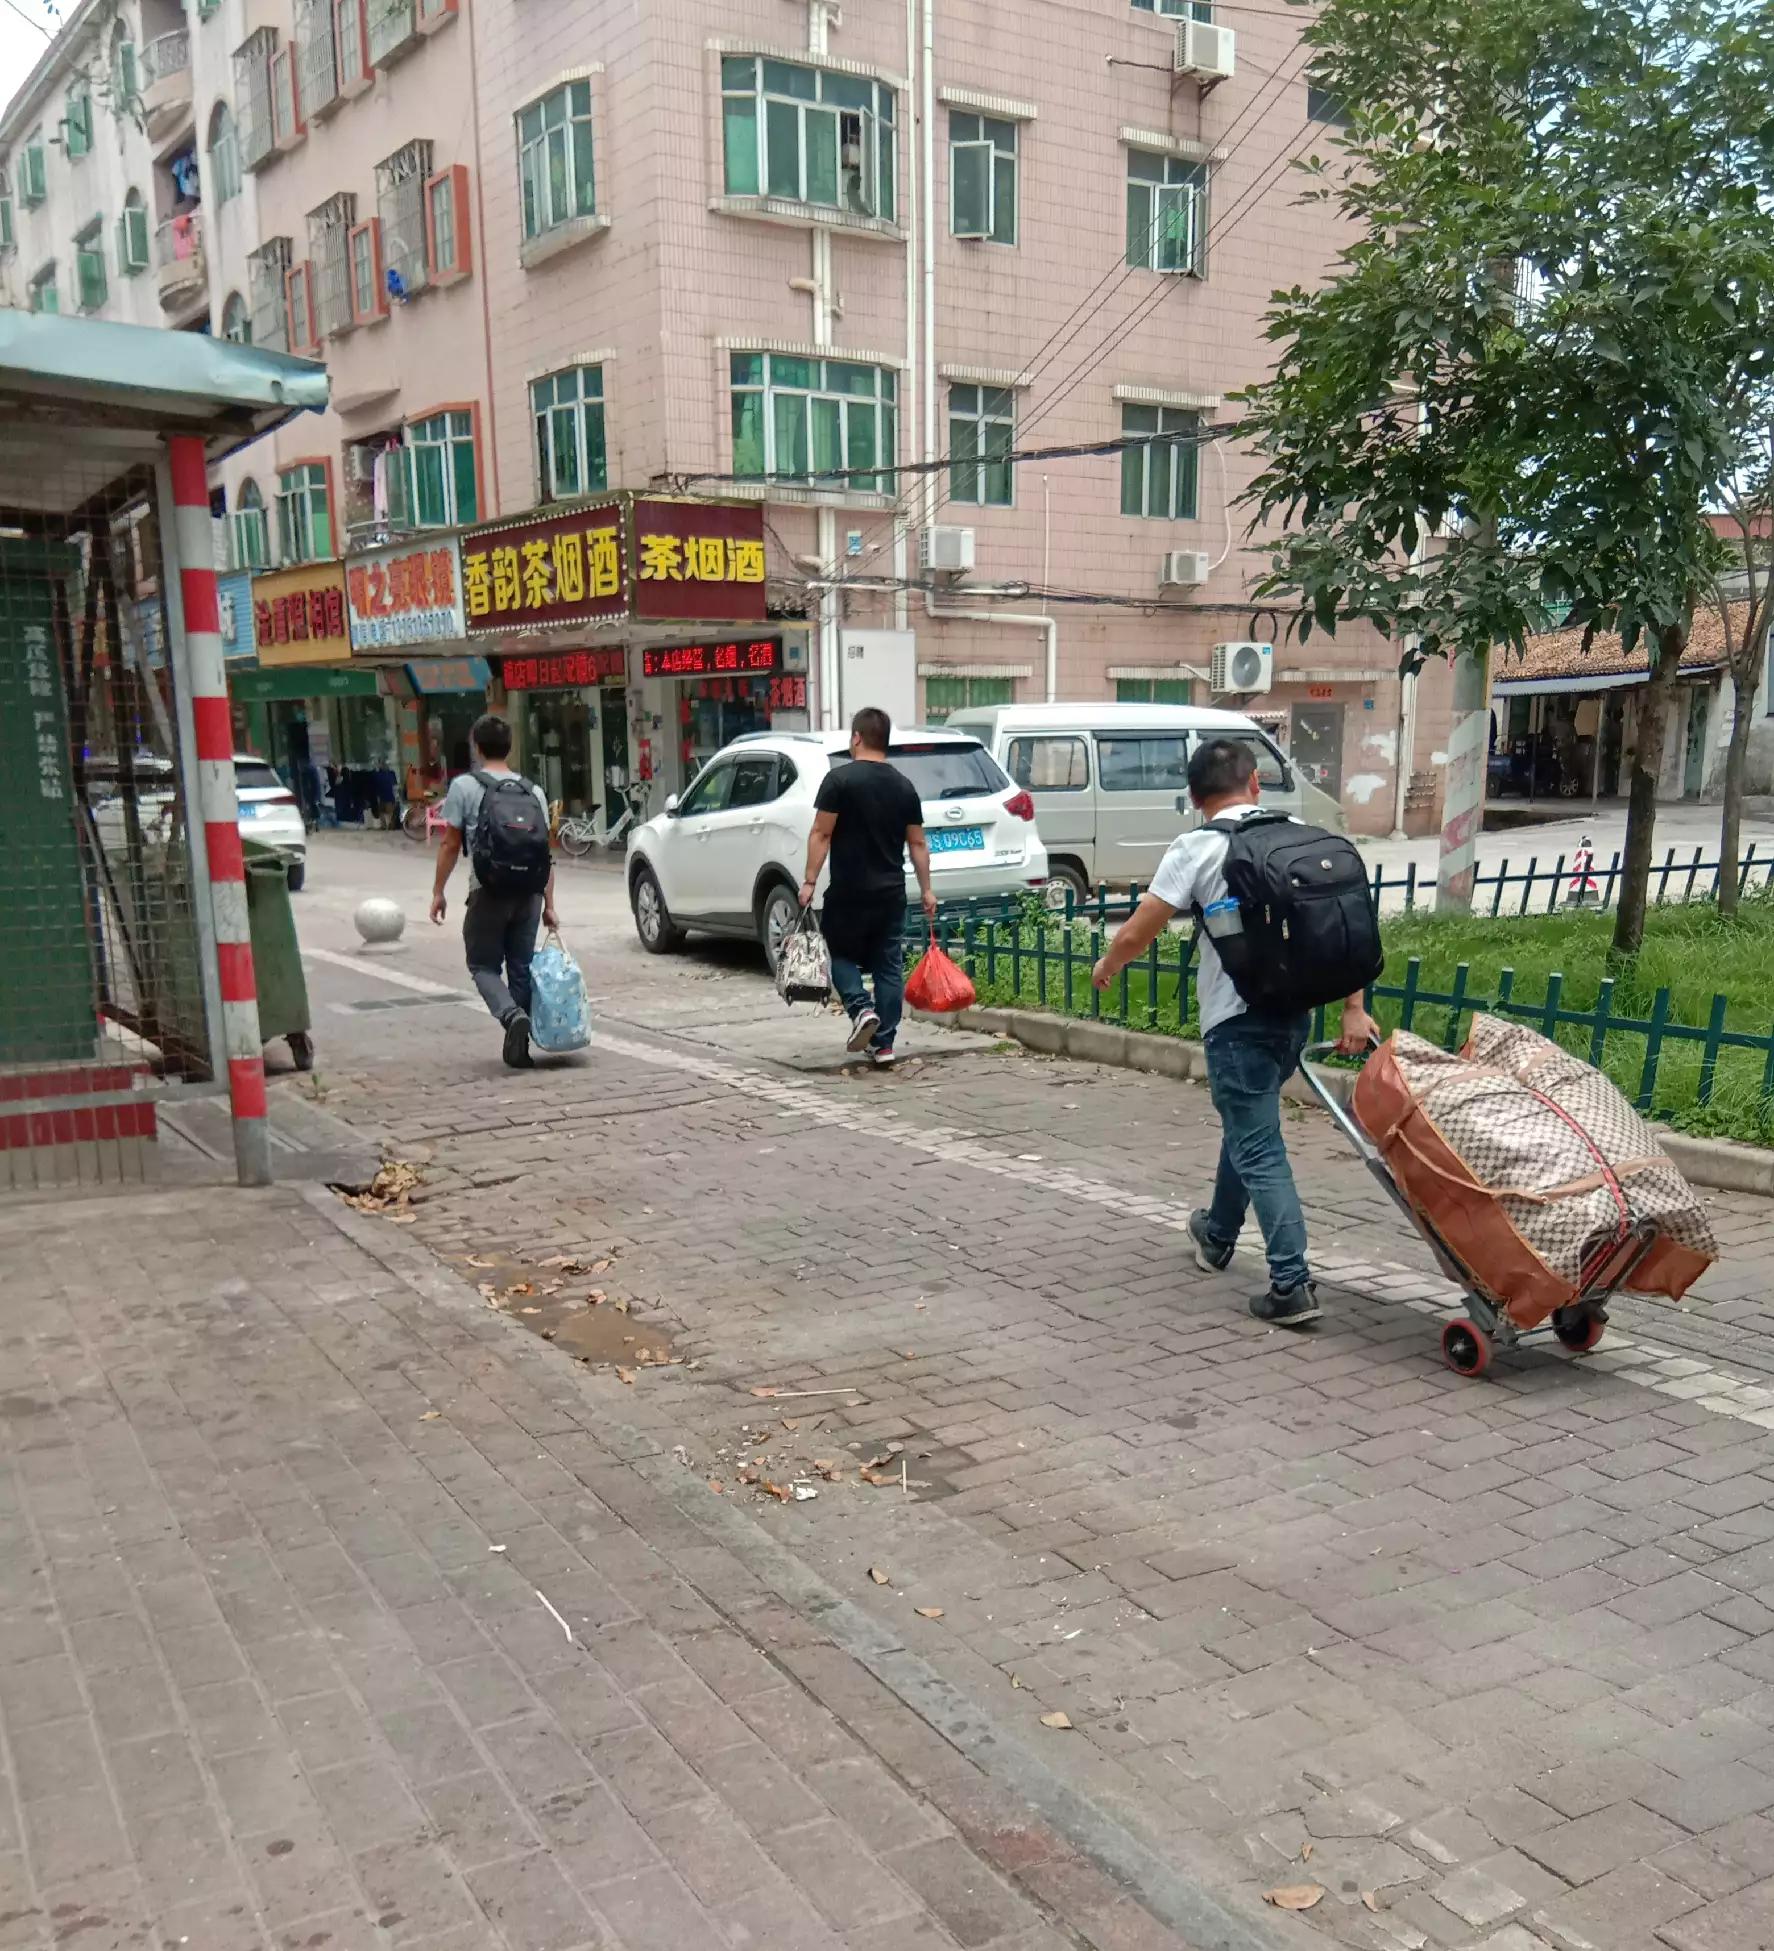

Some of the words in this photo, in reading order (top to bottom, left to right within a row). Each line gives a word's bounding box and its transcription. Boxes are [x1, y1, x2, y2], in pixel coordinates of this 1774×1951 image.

[466, 526, 620, 616] 香韵茶烟酒
[640, 534, 765, 582] 茶烟酒
